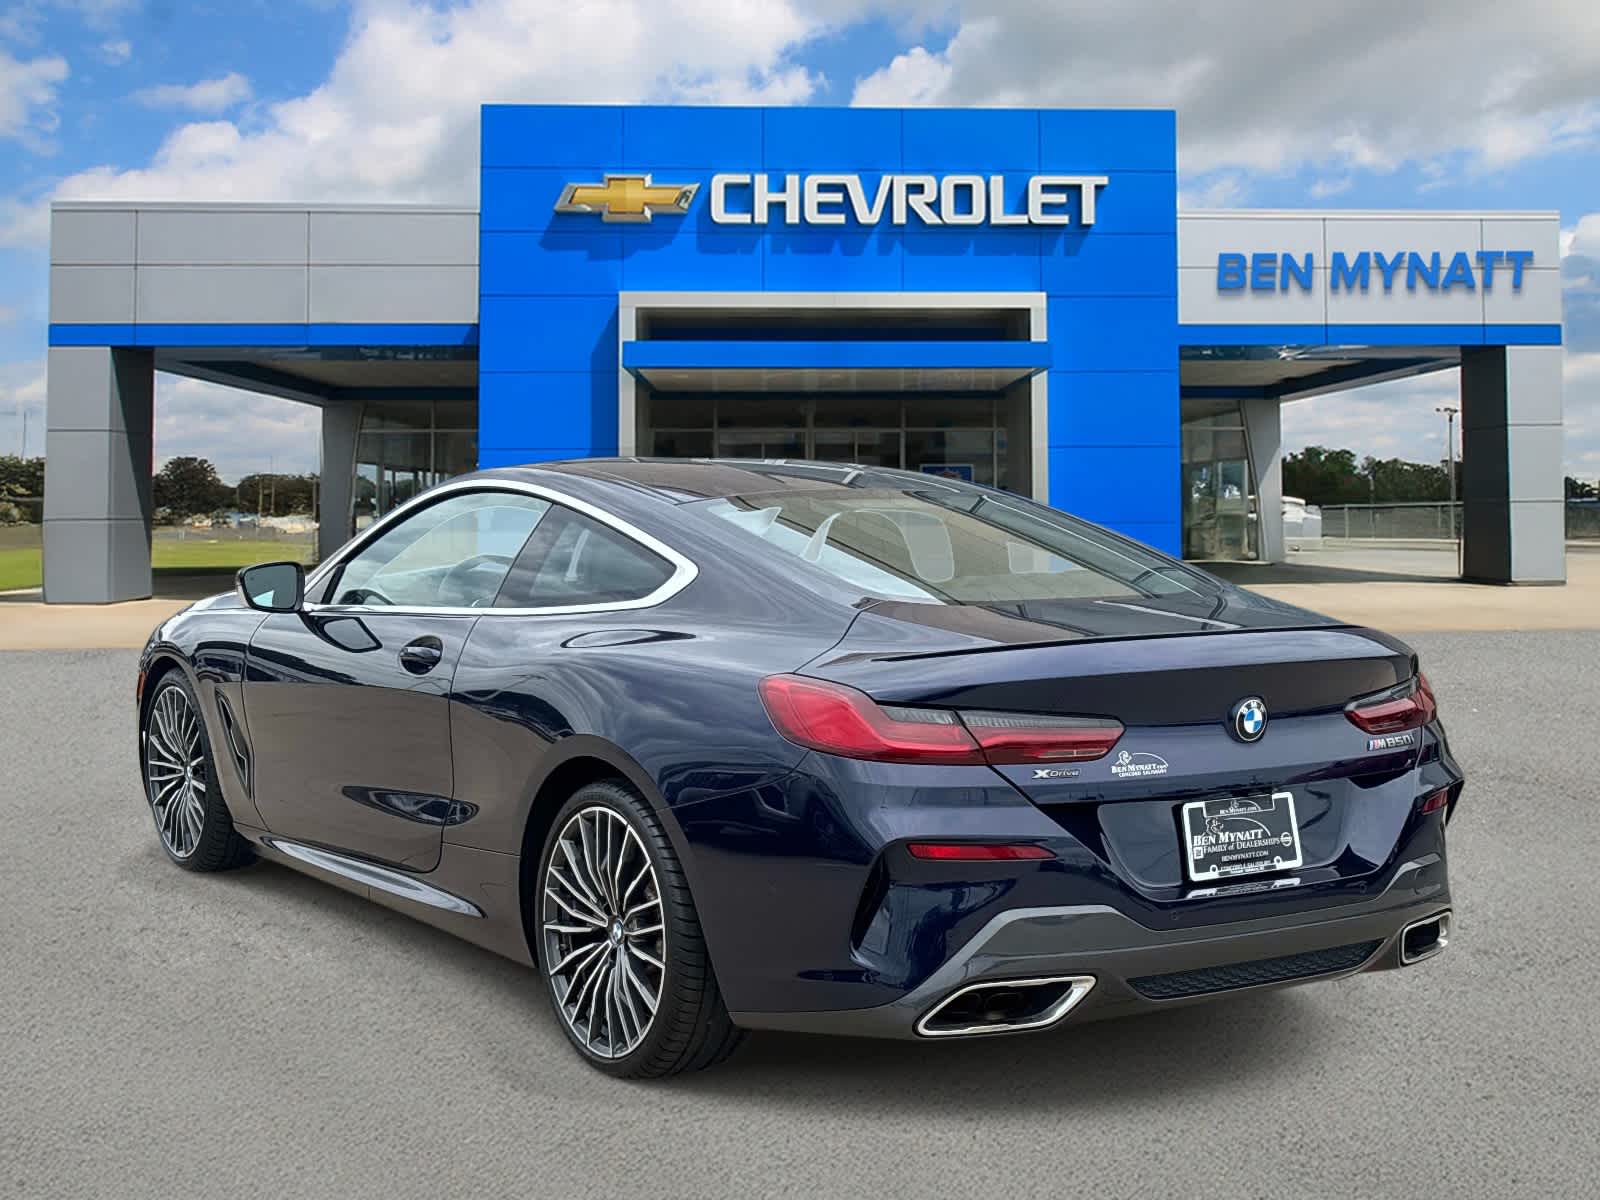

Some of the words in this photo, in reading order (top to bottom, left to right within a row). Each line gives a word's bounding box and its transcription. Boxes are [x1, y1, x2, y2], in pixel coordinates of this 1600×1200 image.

[710, 173, 1109, 226] CHEVROLET
[1217, 252, 1313, 290] BEN
[1330, 251, 1534, 290] MYNATT
[1193, 834, 1216, 847] BEN
[1219, 829, 1264, 843] MYNATT
[1203, 844, 1227, 854] FAMILY
[1236, 838, 1280, 849] DEALERSHIPS
